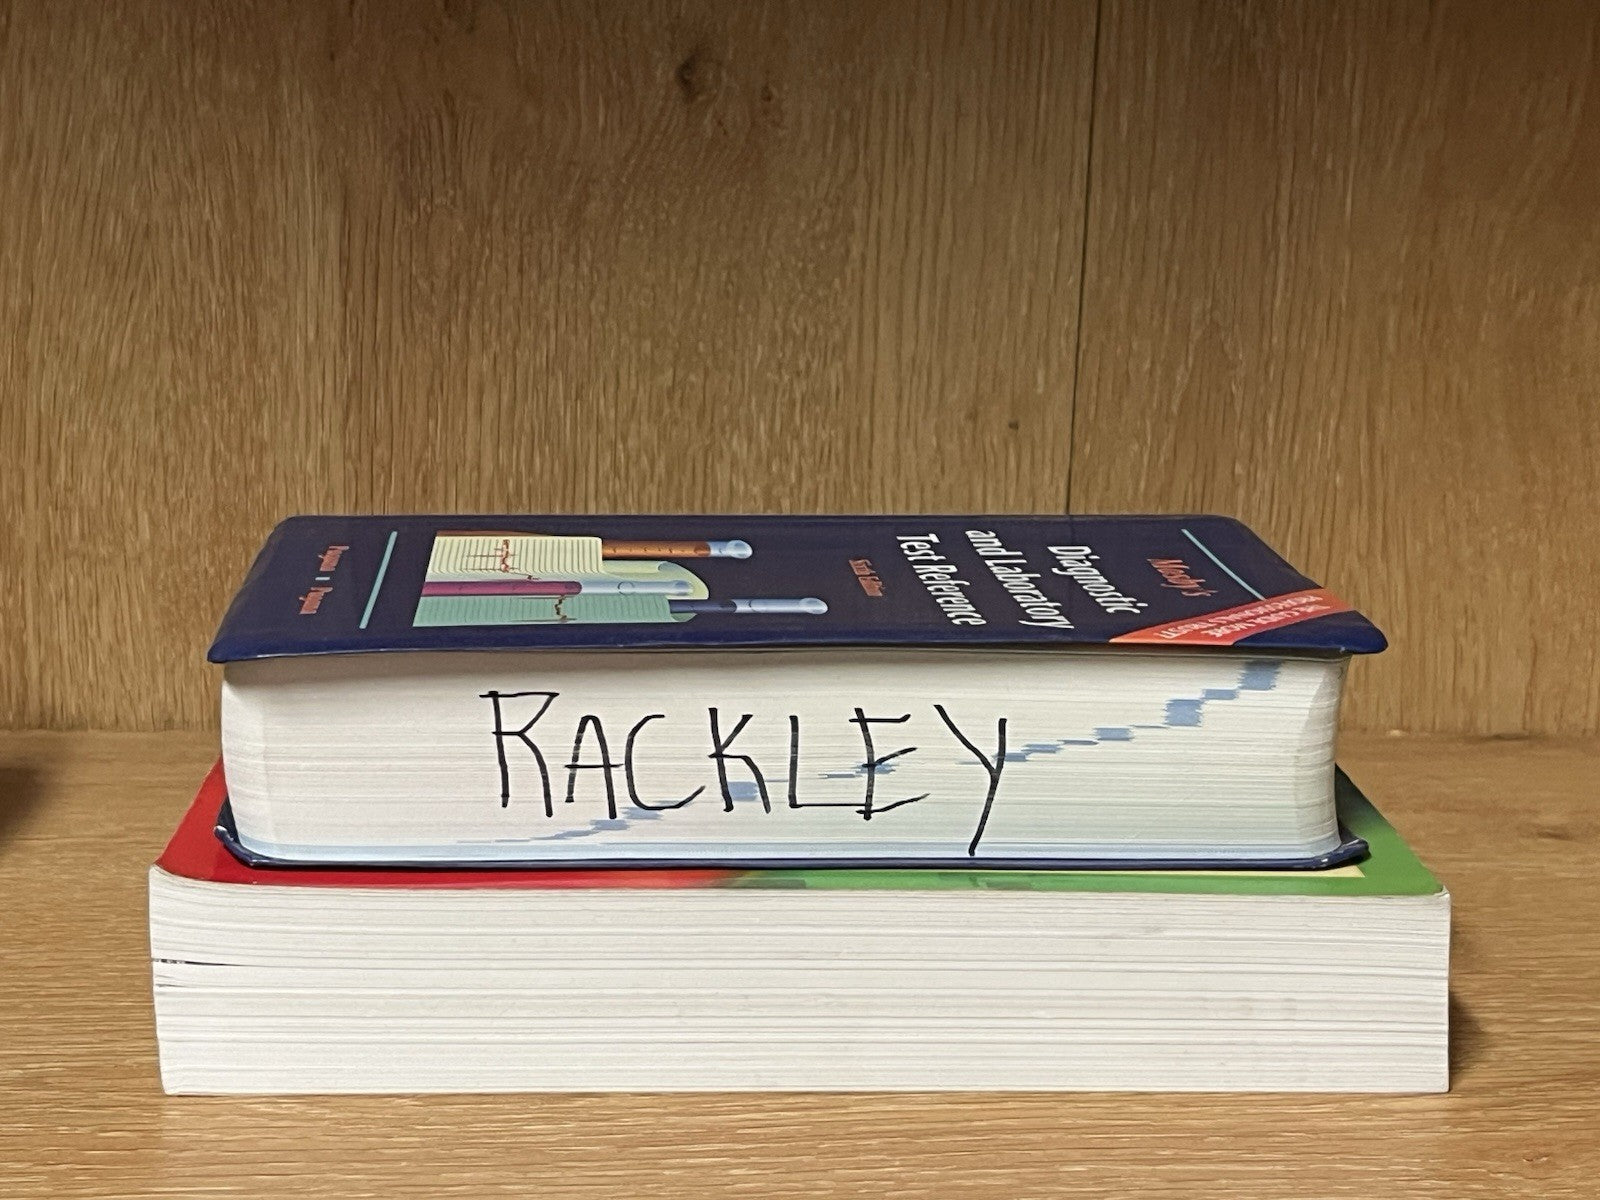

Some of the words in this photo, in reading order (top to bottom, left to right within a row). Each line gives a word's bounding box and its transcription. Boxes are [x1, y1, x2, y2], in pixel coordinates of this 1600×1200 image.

[896, 533, 947, 561] Test
[965, 530, 1023, 556] and
[912, 564, 987, 626] Reference
[985, 559, 1074, 629] Laboratory
[1047, 545, 1149, 614] Diagnostic
[478, 689, 1008, 857] RACKLEY
